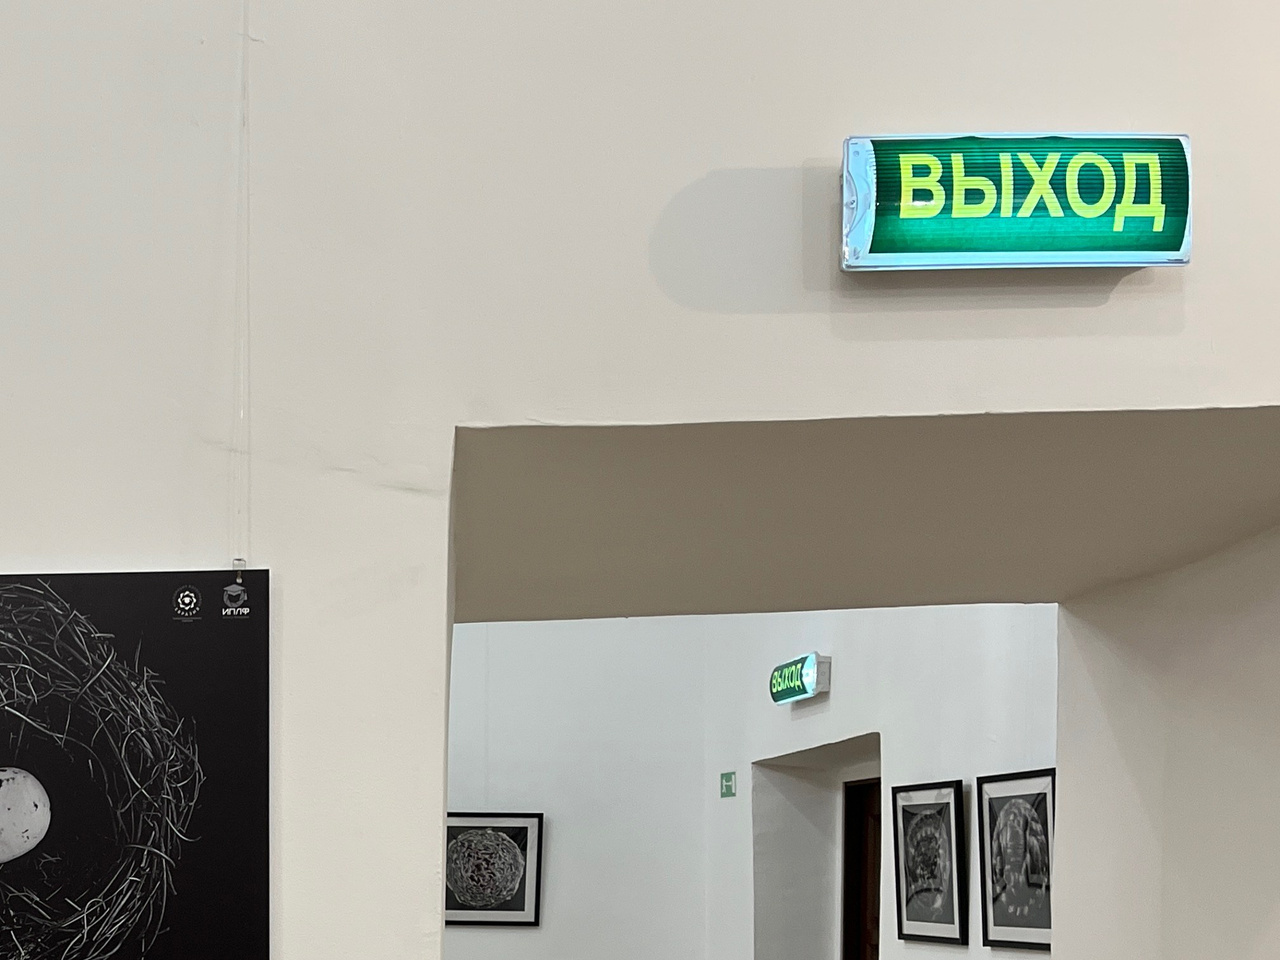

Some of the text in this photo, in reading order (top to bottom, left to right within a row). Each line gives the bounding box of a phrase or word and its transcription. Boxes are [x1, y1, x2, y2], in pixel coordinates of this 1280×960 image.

[898, 152, 1166, 232] ВЫХОД
[222, 607, 250, 616] ИПЛФ
[771, 663, 802, 693] ВЫХОД
